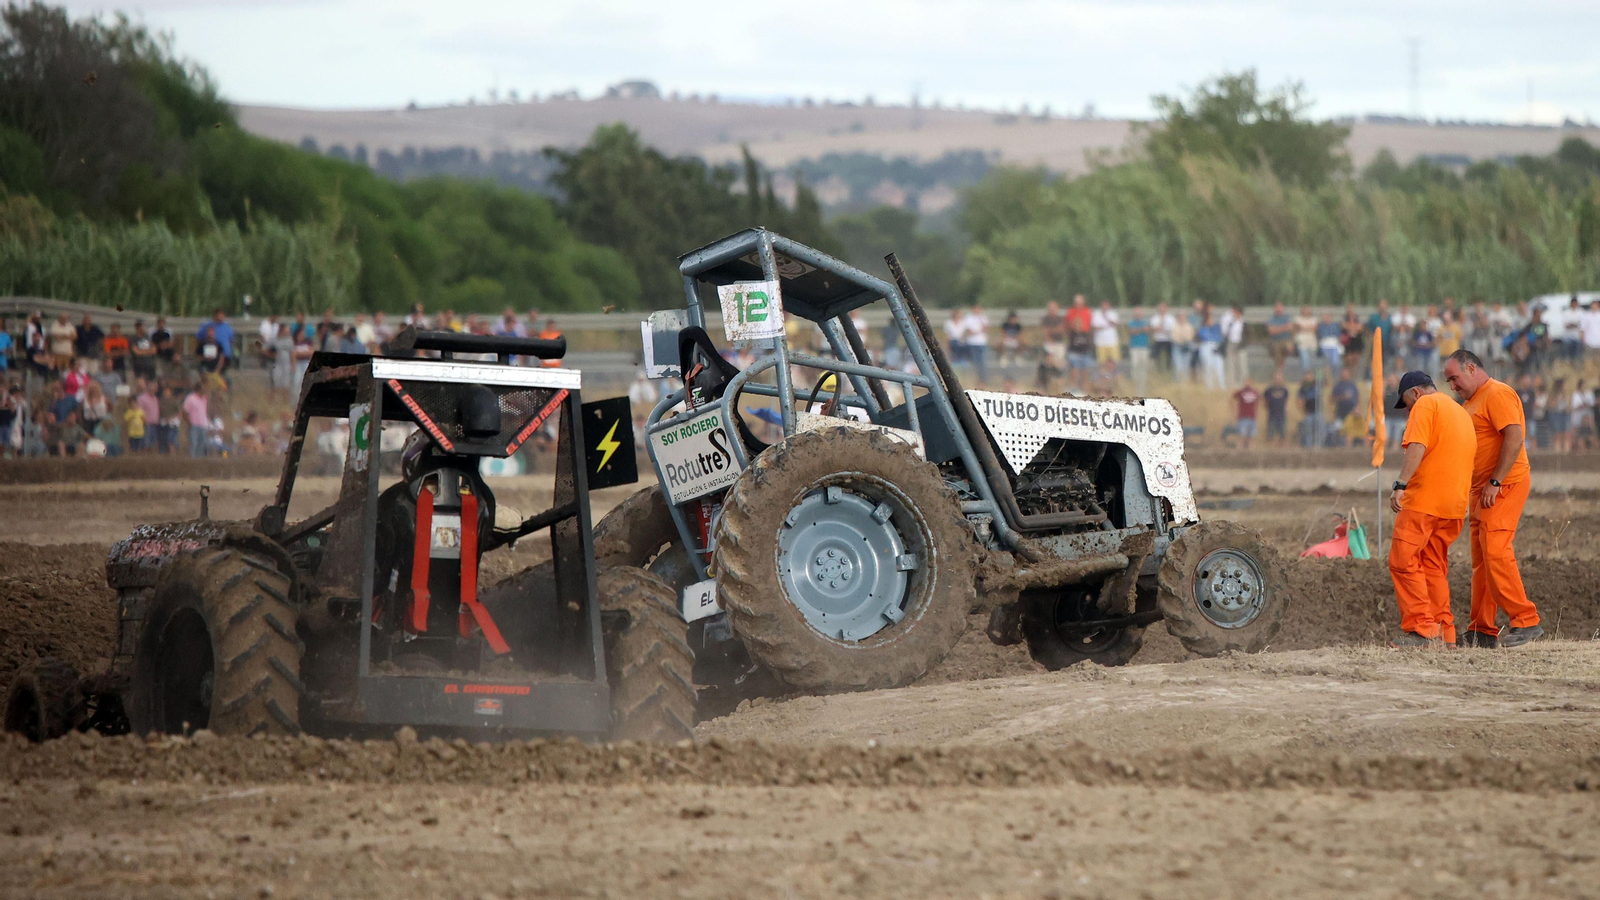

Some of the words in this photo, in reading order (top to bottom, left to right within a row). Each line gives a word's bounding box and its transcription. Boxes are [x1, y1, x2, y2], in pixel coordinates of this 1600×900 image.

[733, 291, 769, 325] 12
[387, 379, 403, 394] EL
[505, 442, 519, 456] EL
[516, 416, 542, 444] RAYO
[539, 388, 570, 421] NEGRO
[661, 430, 679, 446] SOY
[680, 415, 719, 439] ROCIERO
[983, 398, 1039, 422] TURBO
[1044, 404, 1096, 427] DIESEL
[1101, 411, 1171, 437] CAMPOS
[700, 590, 714, 607] EL
